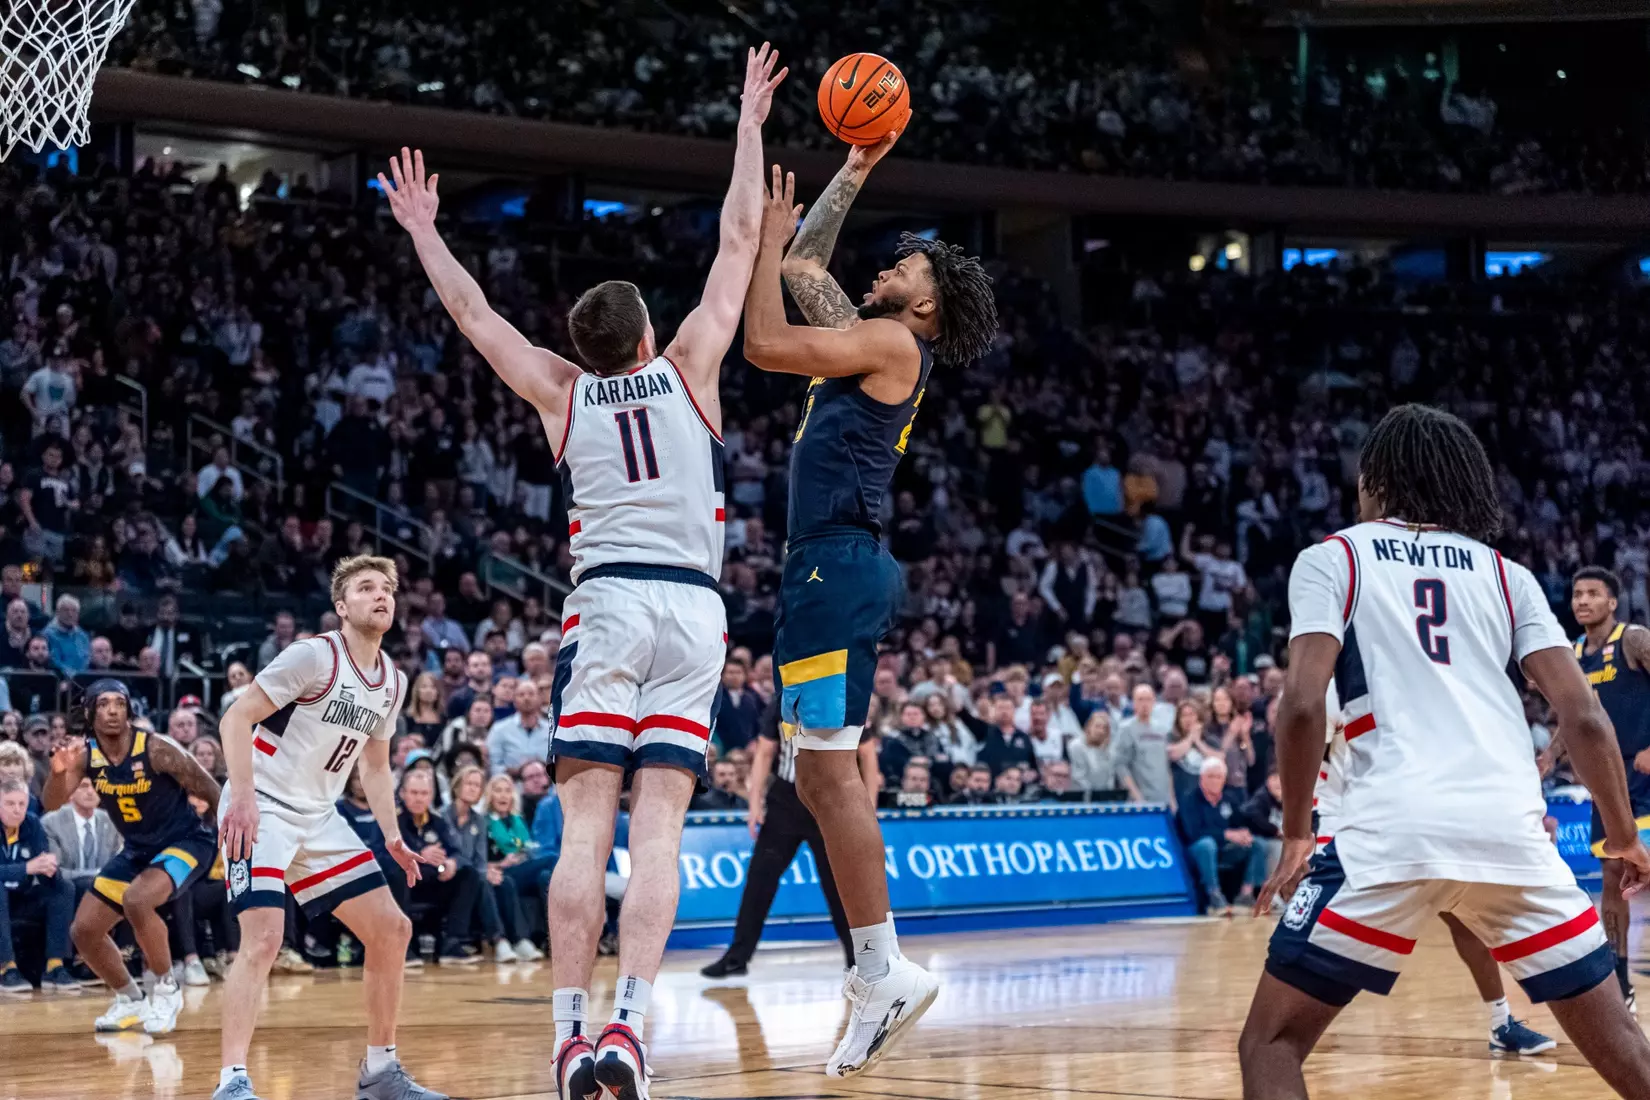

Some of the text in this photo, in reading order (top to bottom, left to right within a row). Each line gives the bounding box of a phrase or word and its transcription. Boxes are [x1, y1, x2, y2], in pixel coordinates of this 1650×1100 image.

[584, 372, 673, 407] KARABAN
[614, 407, 660, 483] 11
[1372, 538, 1474, 571] NEWTON
[1413, 578, 1451, 665] 2
[321, 699, 385, 737] CONNECTIC
[324, 734, 358, 773] 12
[95, 777, 152, 798] Marquette
[117, 797, 143, 823] 5
[907, 837, 1174, 880] ORTHOPAEDICS
